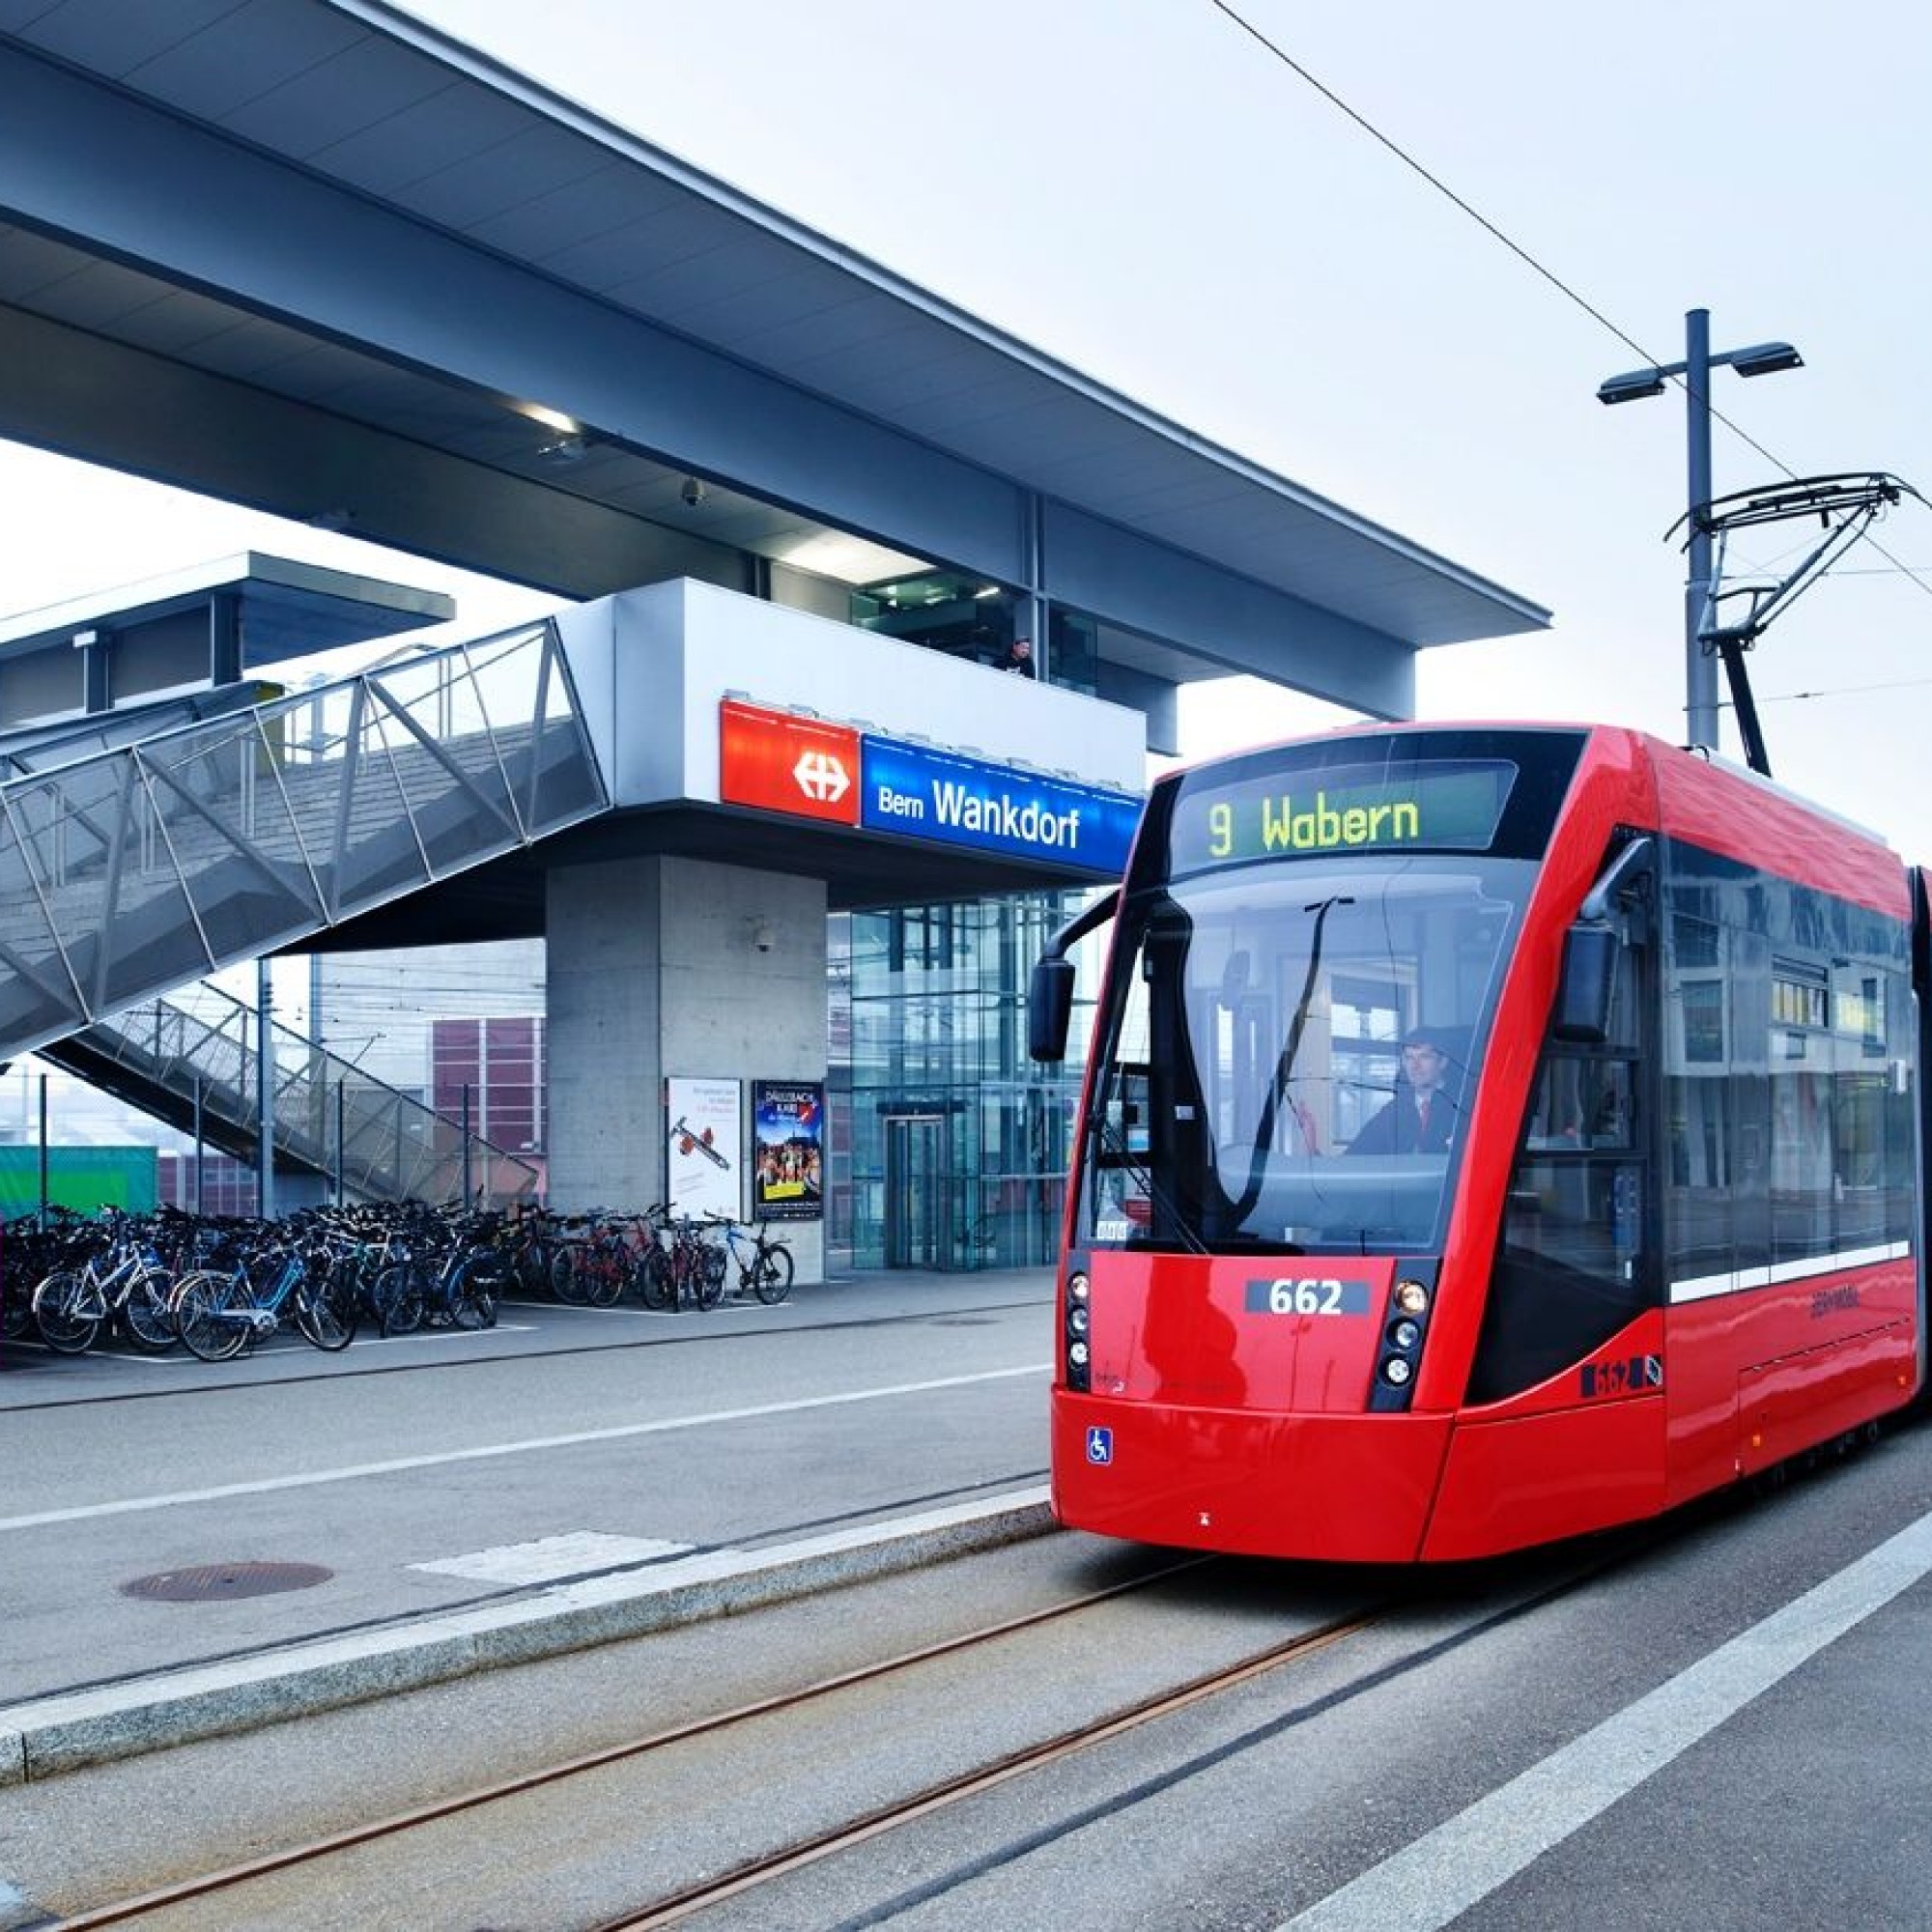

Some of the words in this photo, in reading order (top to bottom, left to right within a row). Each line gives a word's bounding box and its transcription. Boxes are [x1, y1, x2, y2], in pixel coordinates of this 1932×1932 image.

[877, 785, 924, 820] Bern
[932, 779, 1080, 849] Wankdorf
[1209, 803, 1233, 857] 9
[1262, 791, 1419, 851] Wabern
[1268, 1278, 1344, 1316] 662
